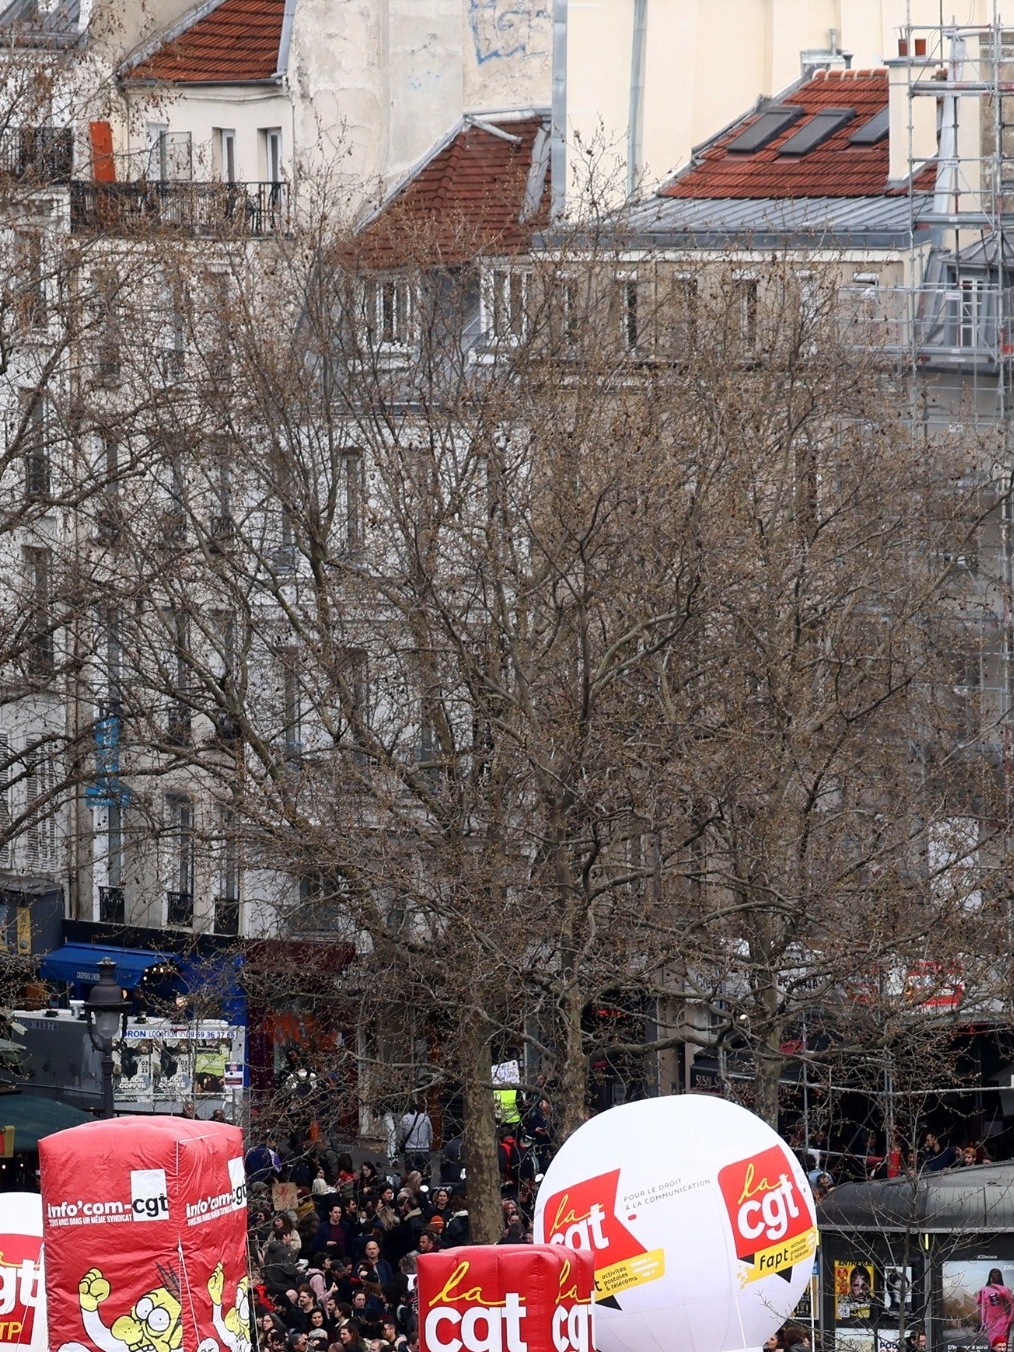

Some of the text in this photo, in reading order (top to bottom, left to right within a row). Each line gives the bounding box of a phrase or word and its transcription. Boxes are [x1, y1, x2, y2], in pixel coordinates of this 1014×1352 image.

[623, 1178, 683, 1203] POUR LE DROIT
[631, 1200, 643, 1209] LA
[644, 1179, 711, 1206] COMMUNICATION
[738, 1163, 784, 1205] la
[69, 1217, 82, 1225] DANS
[91, 1214, 106, 1223] MÊME
[107, 1214, 133, 1223] SYNDICAT
[550, 1194, 600, 1236] la
[737, 1175, 800, 1240] cgt
[602, 1266, 627, 1279] activités
[759, 1248, 789, 1271] fapt
[428, 1260, 506, 1307] la
[555, 1259, 590, 1304] la
[603, 1273, 629, 1286] postales
[611, 1276, 638, 1290] télécoms
